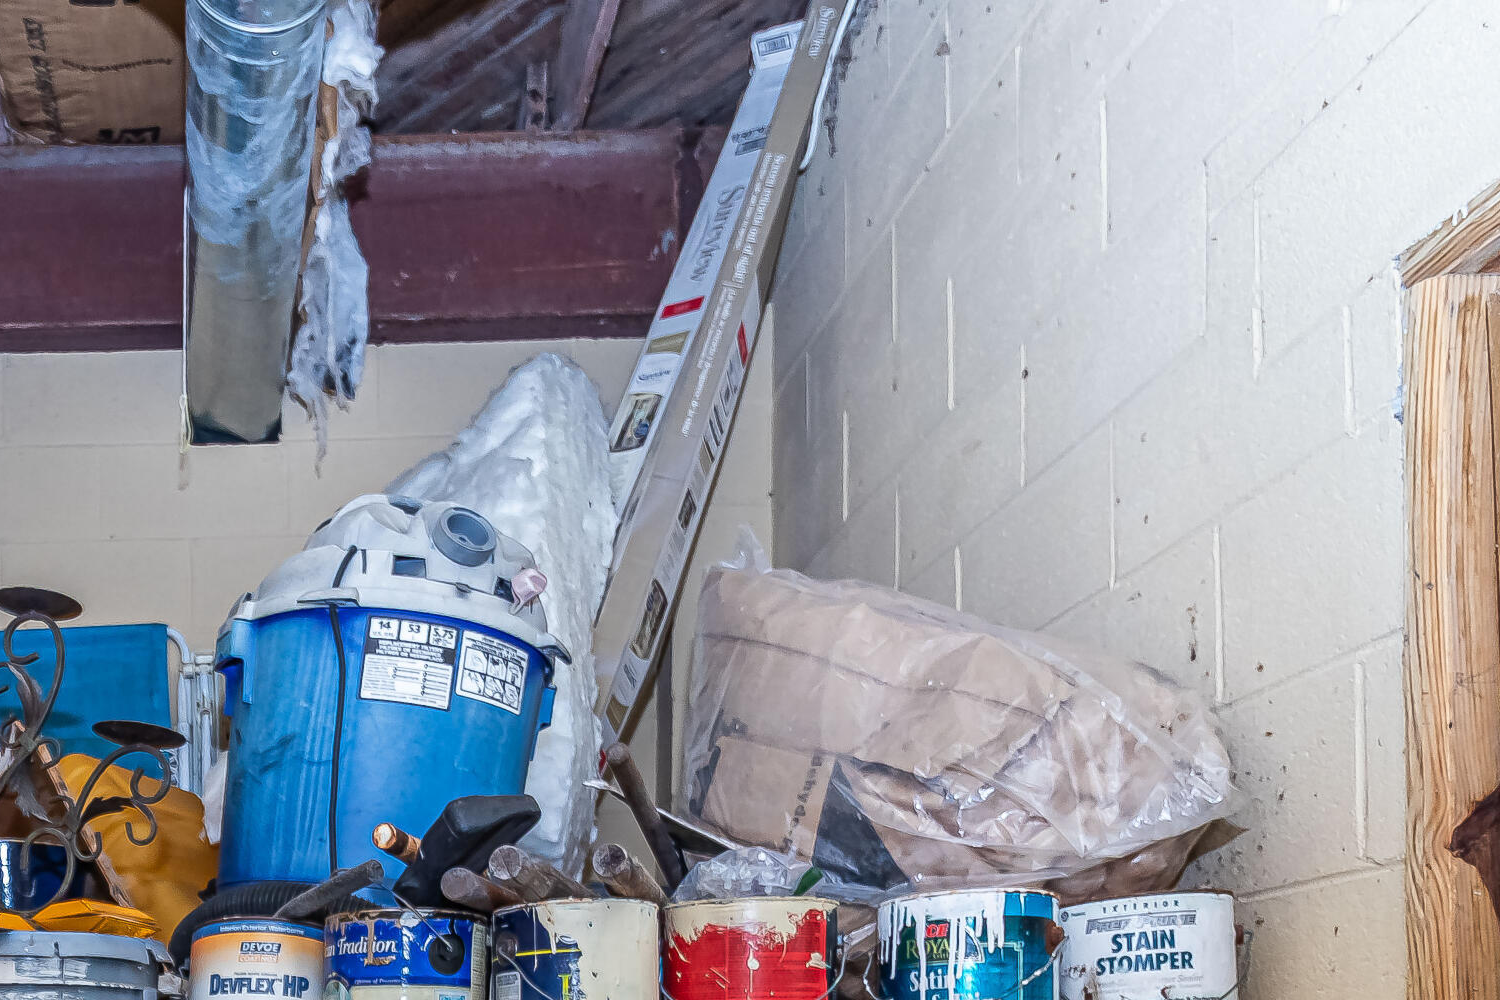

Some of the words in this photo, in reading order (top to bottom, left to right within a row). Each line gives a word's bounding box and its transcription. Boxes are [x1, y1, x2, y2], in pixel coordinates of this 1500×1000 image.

[379, 621, 391, 630] 14
[408, 624, 421, 633] 53
[433, 627, 454, 639] 5.75
[1102, 899, 1180, 914] EXTERIOR
[242, 942, 279, 953] DEVOE
[337, 936, 397, 955] Tradiion
[1112, 929, 1176, 954] STAIN
[1096, 951, 1194, 977] STOMPER
[209, 974, 276, 996] DEVFLEX
[282, 974, 310, 998] HP
